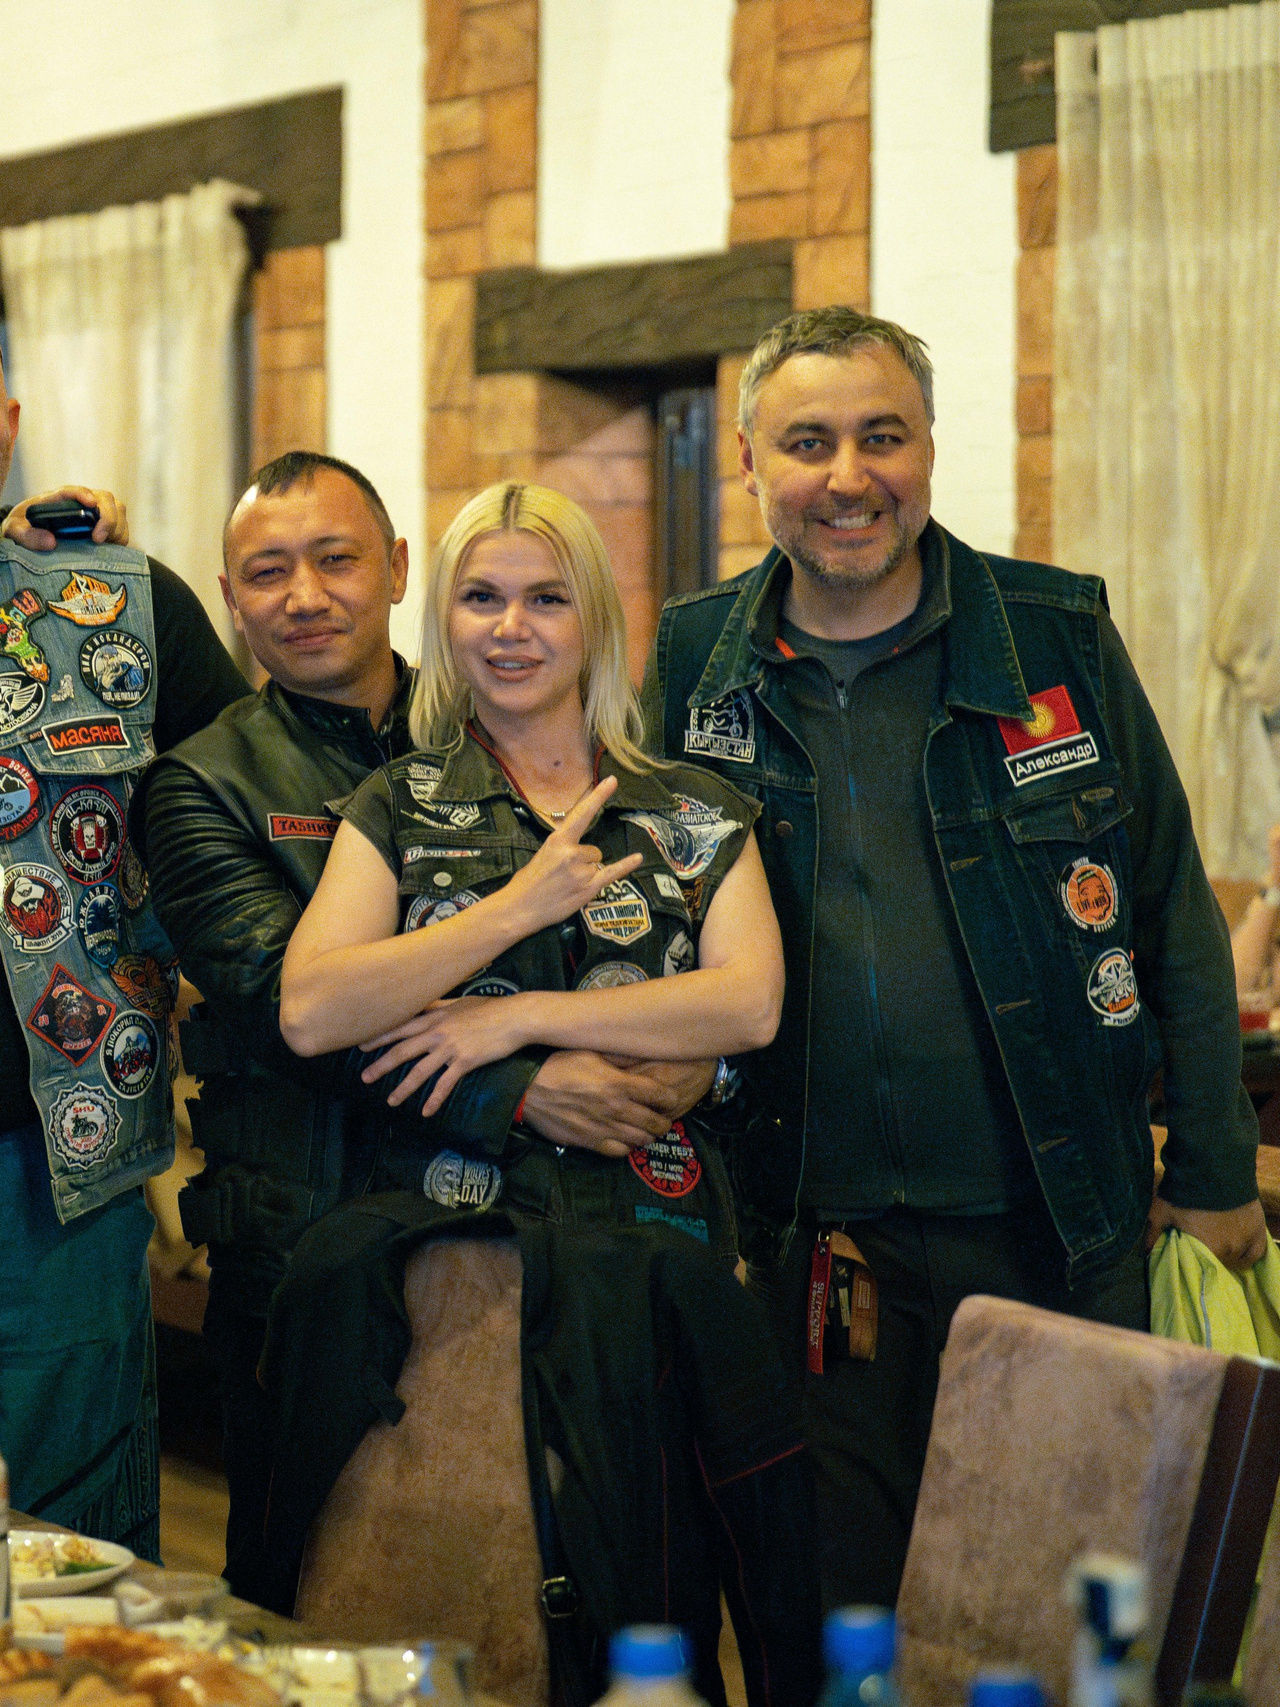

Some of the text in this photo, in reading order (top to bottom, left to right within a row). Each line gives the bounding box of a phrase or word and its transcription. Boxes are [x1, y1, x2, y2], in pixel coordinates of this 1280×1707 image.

[1015, 743, 1093, 778] Александр
[106, 1015, 134, 1048] ПОКОРИЛ
[460, 1185, 488, 1205] DAY
